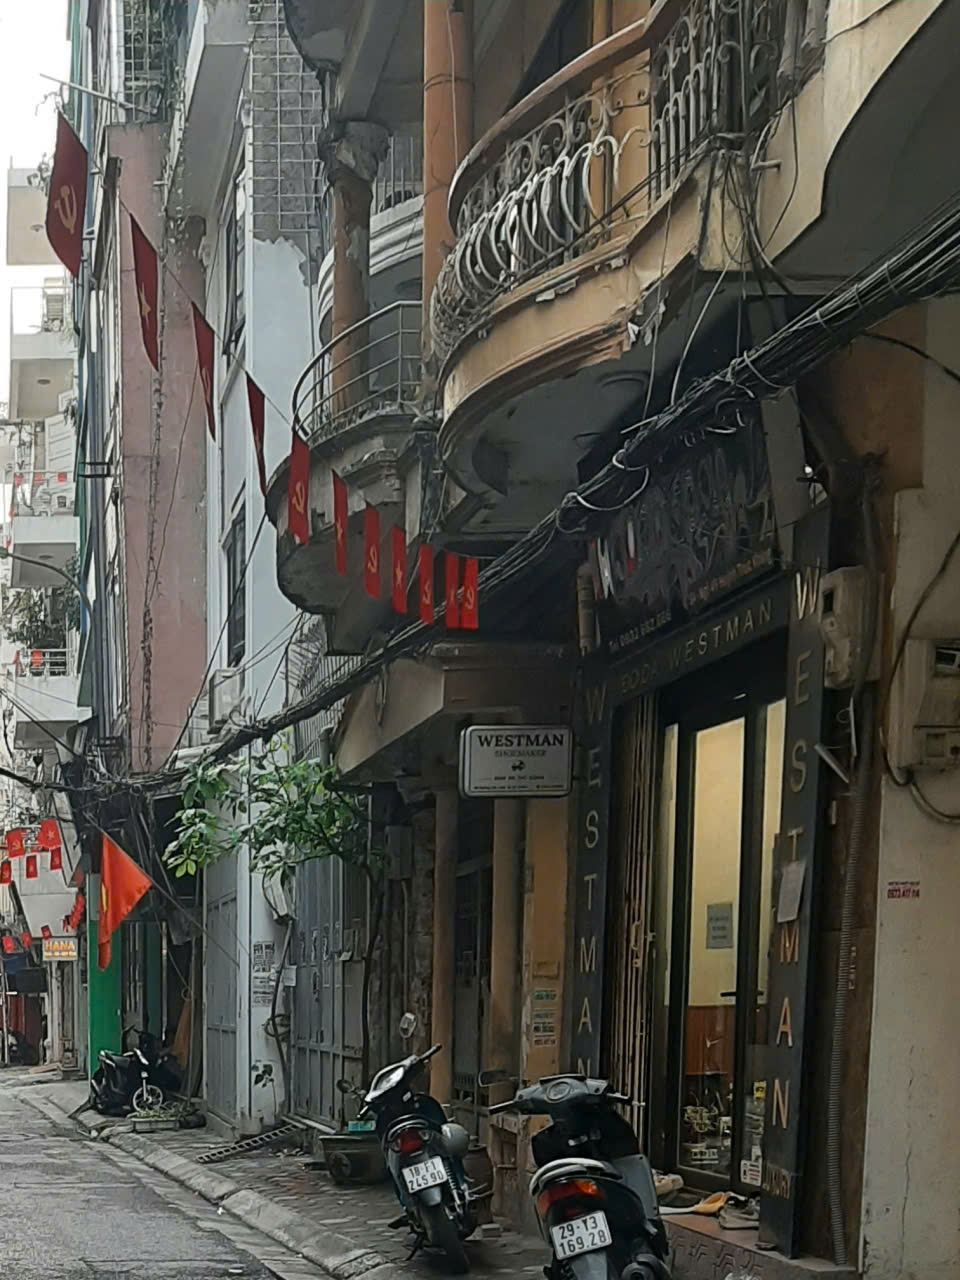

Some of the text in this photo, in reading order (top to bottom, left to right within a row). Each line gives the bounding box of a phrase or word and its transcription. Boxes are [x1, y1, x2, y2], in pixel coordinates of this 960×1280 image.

[670, 597, 772, 669] WESTMAN
[477, 733, 564, 747] WESTMAN
[45, 940, 76, 951] HANA
[559, 1230, 608, 1256] 169.28
